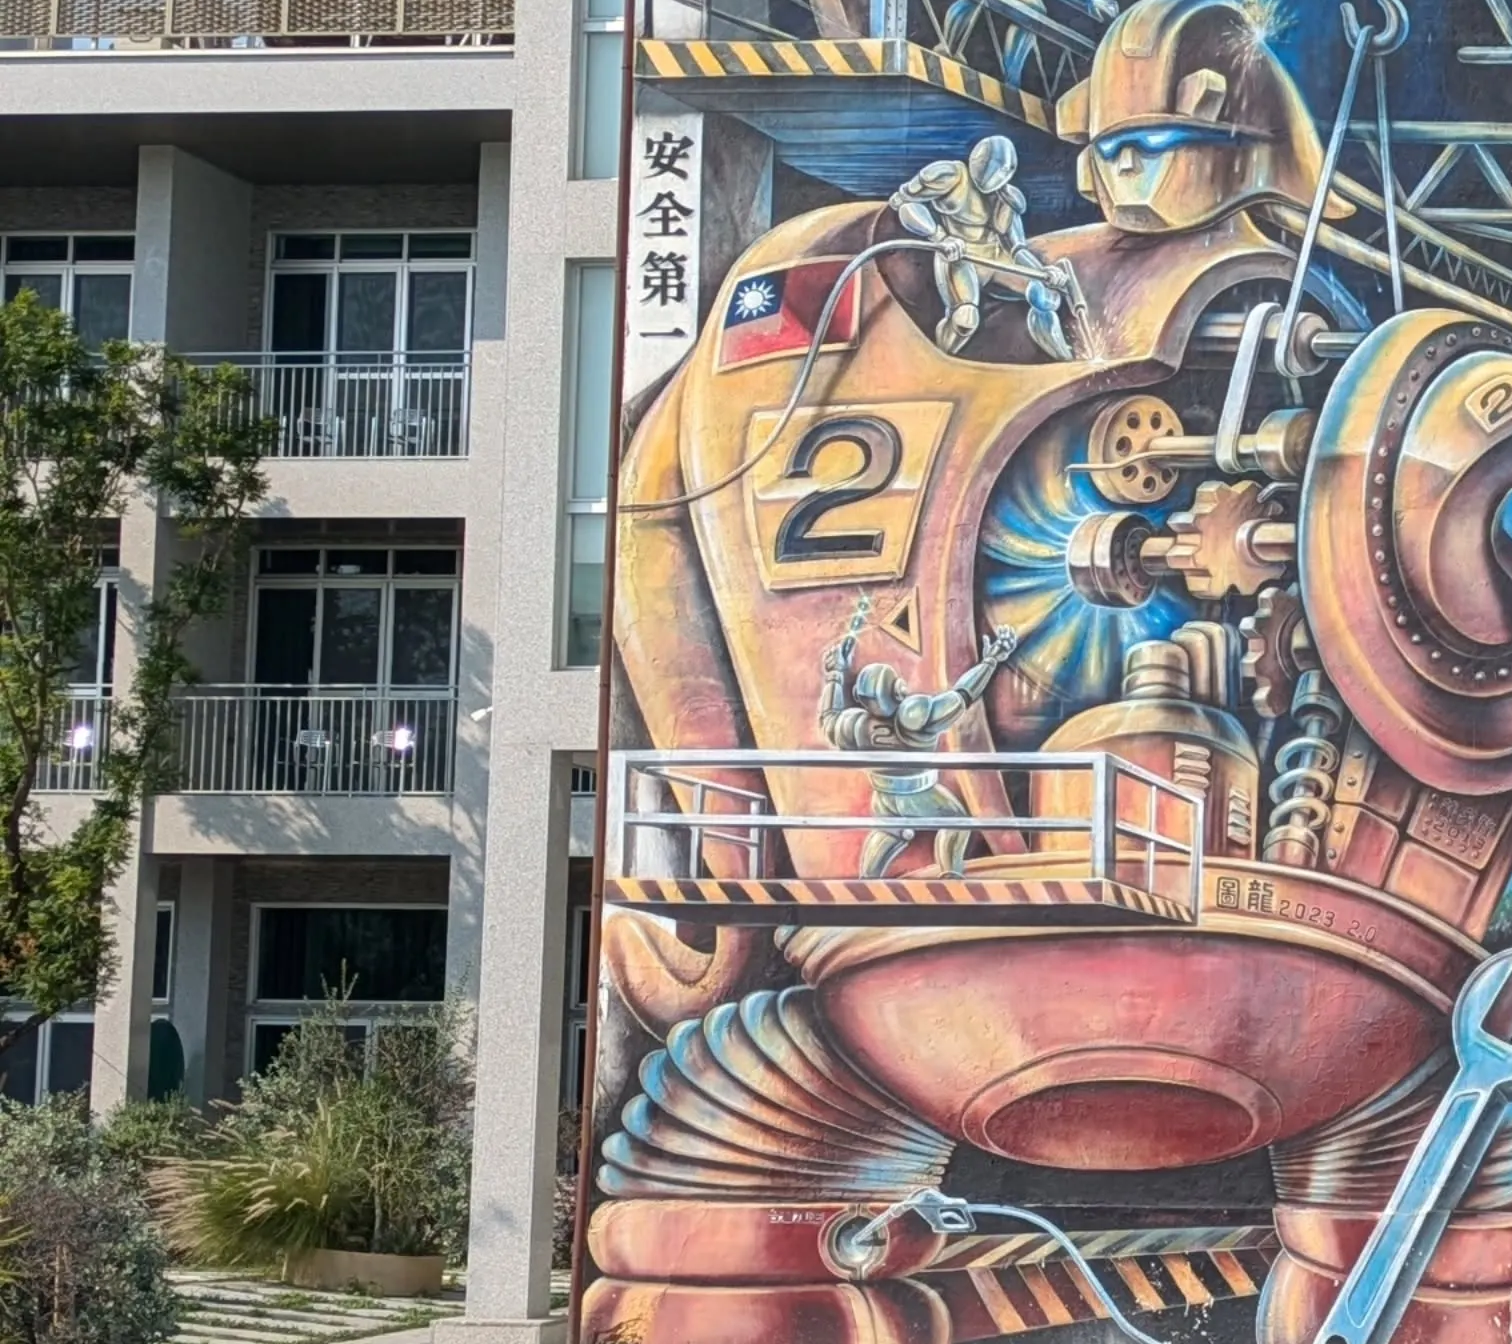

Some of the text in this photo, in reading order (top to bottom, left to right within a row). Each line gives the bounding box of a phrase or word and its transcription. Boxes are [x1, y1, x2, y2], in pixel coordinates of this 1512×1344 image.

[636, 131, 695, 339] 安全第一
[774, 414, 904, 563] 2
[1216, 876, 1377, 944] 圖龍 2023 2.0
